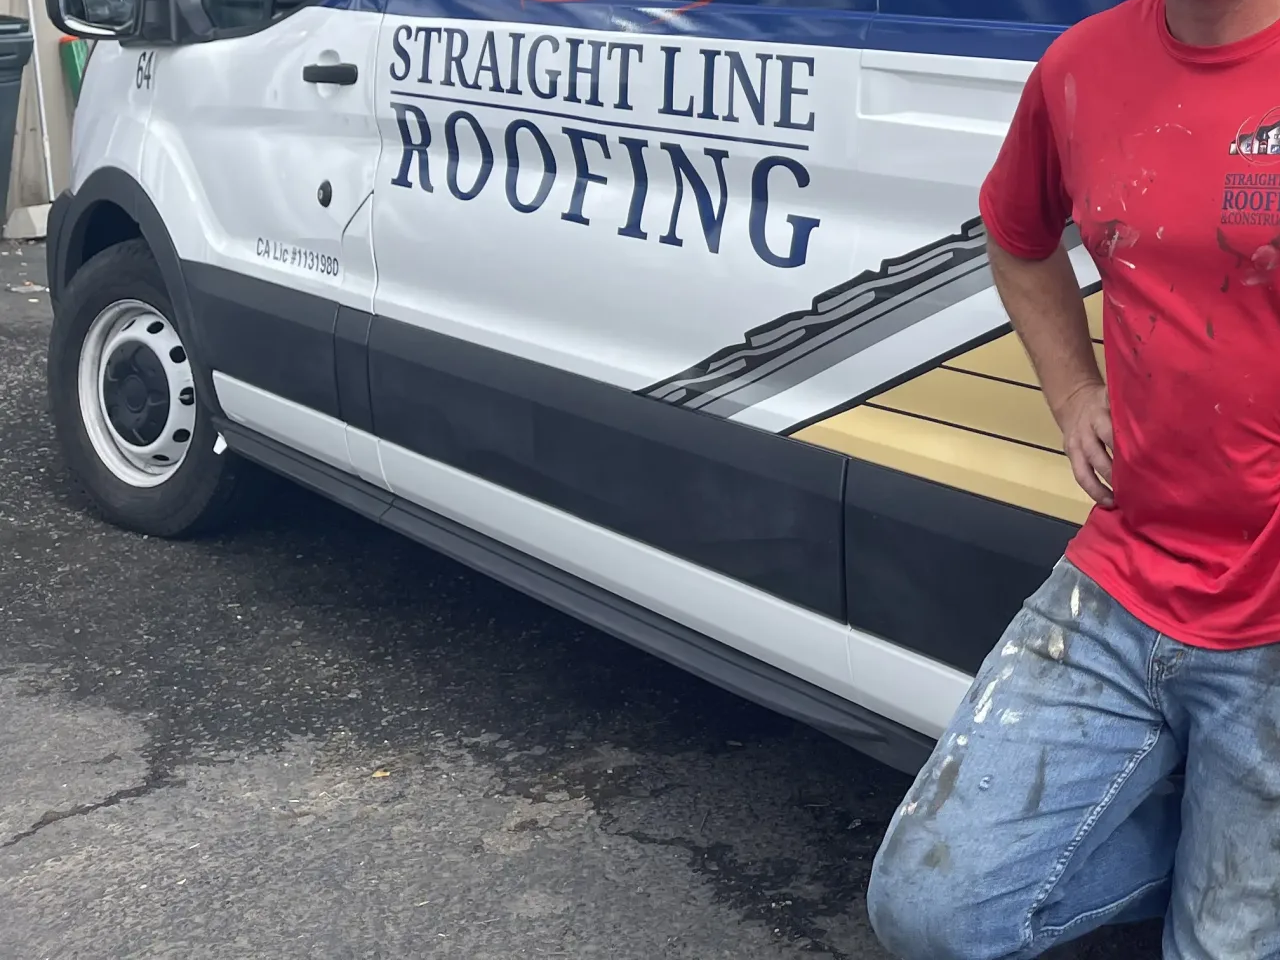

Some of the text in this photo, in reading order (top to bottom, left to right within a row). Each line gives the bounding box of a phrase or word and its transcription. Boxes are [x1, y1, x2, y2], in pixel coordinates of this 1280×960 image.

[136, 51, 154, 89] 64
[390, 24, 816, 133] STRAIGHT LINE
[390, 101, 820, 269] ROOFING
[256, 237, 339, 277] CA Lic #1131980
